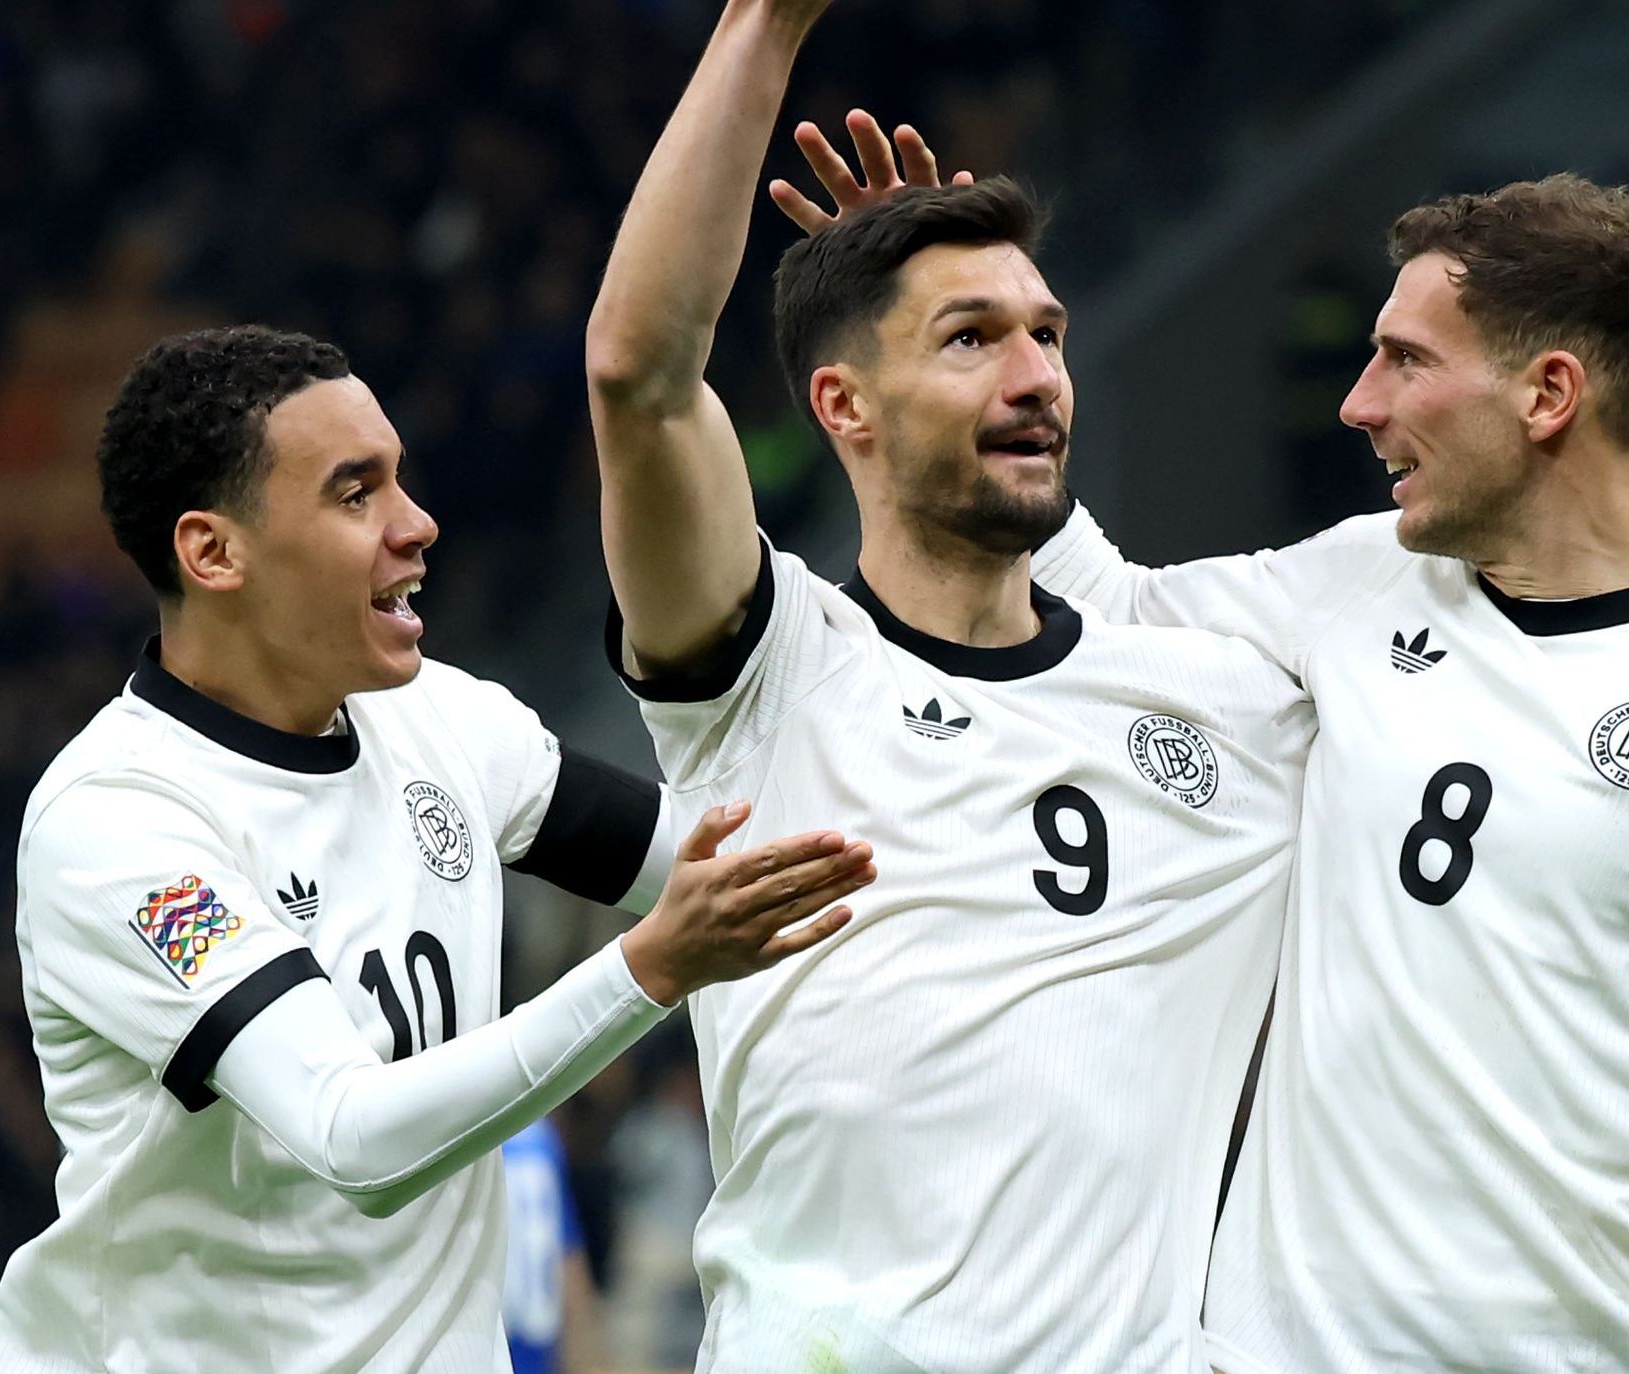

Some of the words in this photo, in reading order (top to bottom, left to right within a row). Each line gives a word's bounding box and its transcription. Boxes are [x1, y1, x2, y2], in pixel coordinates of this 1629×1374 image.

[1134, 723, 1169, 792] DEUTSCHER
[1033, 785, 1109, 916] 9
[1399, 762, 1492, 905] 8
[359, 930, 457, 1062] 10
